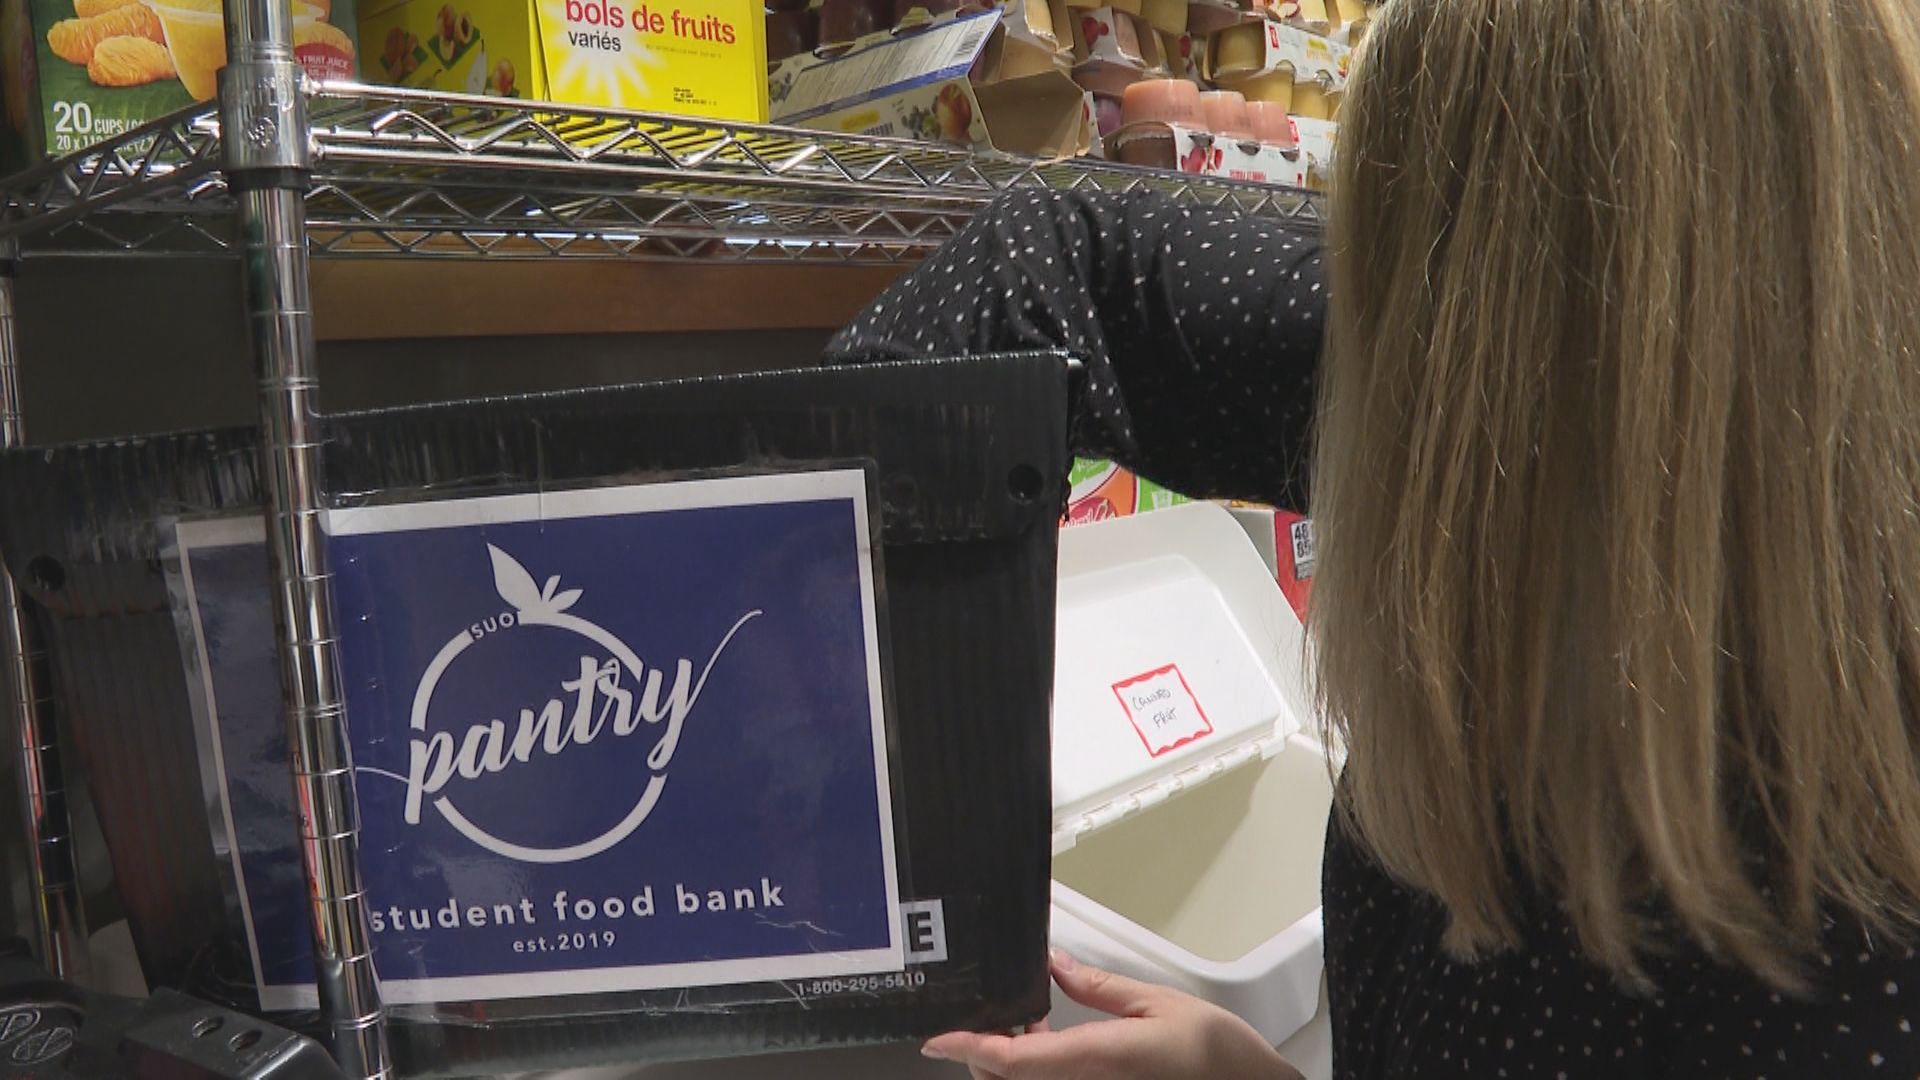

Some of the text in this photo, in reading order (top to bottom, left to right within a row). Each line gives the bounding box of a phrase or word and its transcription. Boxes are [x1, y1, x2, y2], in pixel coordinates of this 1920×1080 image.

[566, 0, 736, 44] bols de fruits
[568, 31, 622, 52] variés
[53, 101, 92, 134] 20
[57, 135, 71, 150] 20
[471, 612, 515, 639] SUO
[404, 609, 763, 826] pantry
[370, 877, 785, 933] student food bank
[513, 930, 617, 953] est.2019
[907, 911, 935, 953] E
